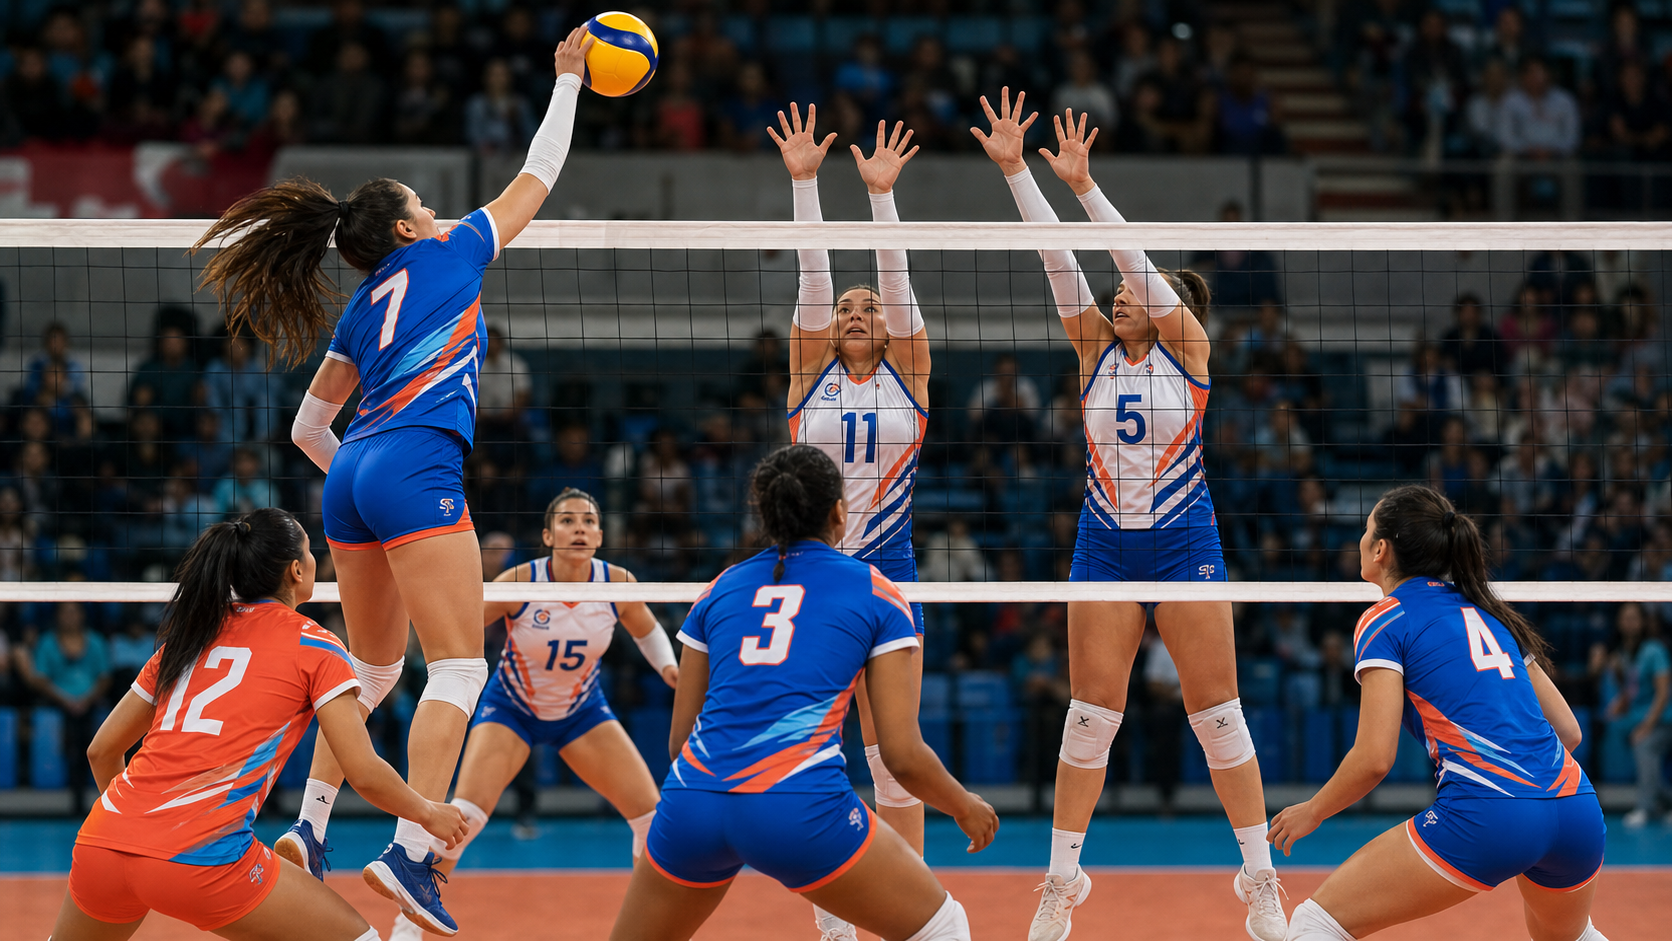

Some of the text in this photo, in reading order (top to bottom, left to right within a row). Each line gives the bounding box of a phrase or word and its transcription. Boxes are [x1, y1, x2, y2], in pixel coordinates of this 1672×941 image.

[371, 268, 409, 352] 7
[841, 412, 876, 463] 11
[1116, 394, 1146, 444] 5
[545, 640, 588, 671] 15
[738, 585, 805, 666] 3
[1460, 607, 1515, 680] 4
[160, 646, 252, 736] 12
